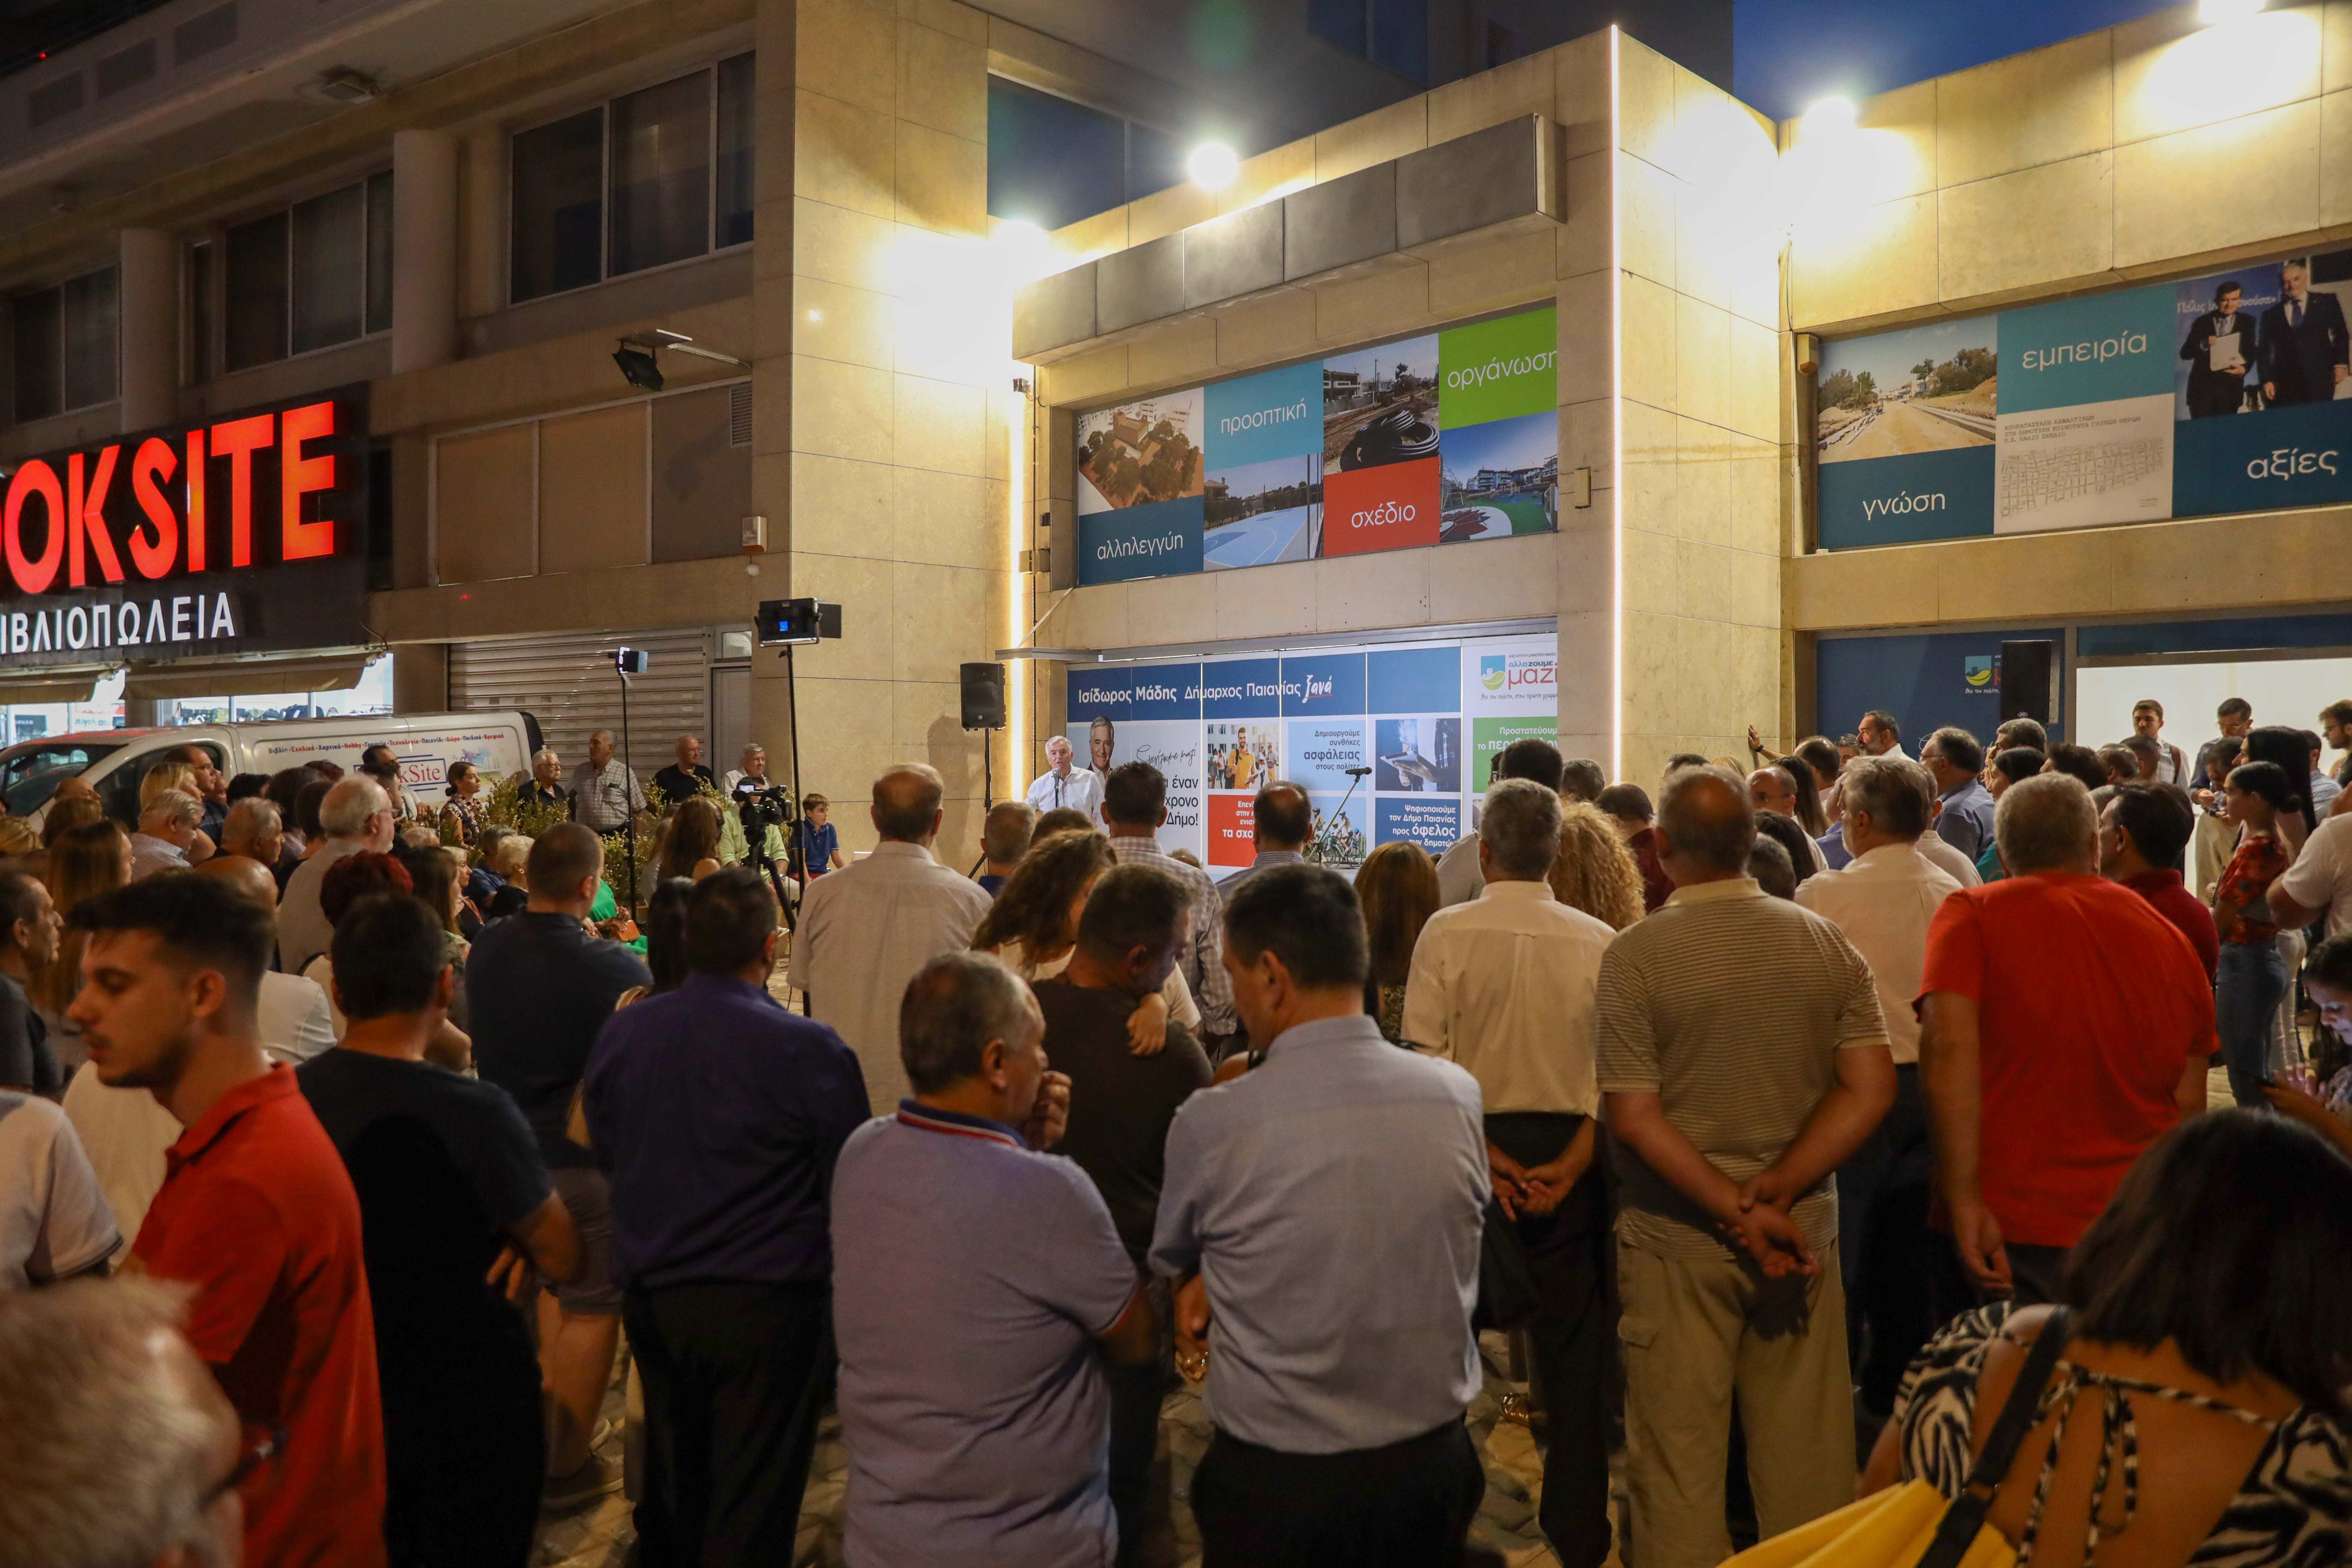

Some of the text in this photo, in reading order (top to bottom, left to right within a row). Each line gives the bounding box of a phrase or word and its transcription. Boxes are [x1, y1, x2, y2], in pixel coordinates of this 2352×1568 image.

[2022, 330, 2147, 371] εμπειρία
[1221, 398, 1306, 436] προοπτική
[2247, 448, 2338, 480] αξίες
[0, 401, 334, 594] OKSITE
[1863, 491, 1945, 520] γνώση
[1351, 501, 1415, 528] σχέδιο
[1097, 531, 1183, 560] αλληλεγγύη
[0, 592, 235, 654] ΙΒΛΙΟΠΩΛΕΙΑ
[1079, 674, 1332, 705] Ισίδωρος Μάδης Δήμαρχος Παιανίας ξανά
[1315, 729, 1360, 737] Δημιουργούμε
[1500, 726, 1557, 735] Προστατεύουμ
[1329, 738, 1360, 746] συνθήκες
[1304, 748, 1360, 762] ασφάλειας
[400, 763, 441, 783] kSite
[1172, 774, 1198, 788] έναν
[1165, 797, 1198, 809] χρονο
[1405, 804, 1456, 814] Ψηφιοποιούμε
[1166, 811, 1198, 828] Δήμο!
[1403, 814, 1421, 823] Δήμο
[1424, 815, 1456, 824] Παιανίας
[1412, 823, 1455, 839] όφελος
